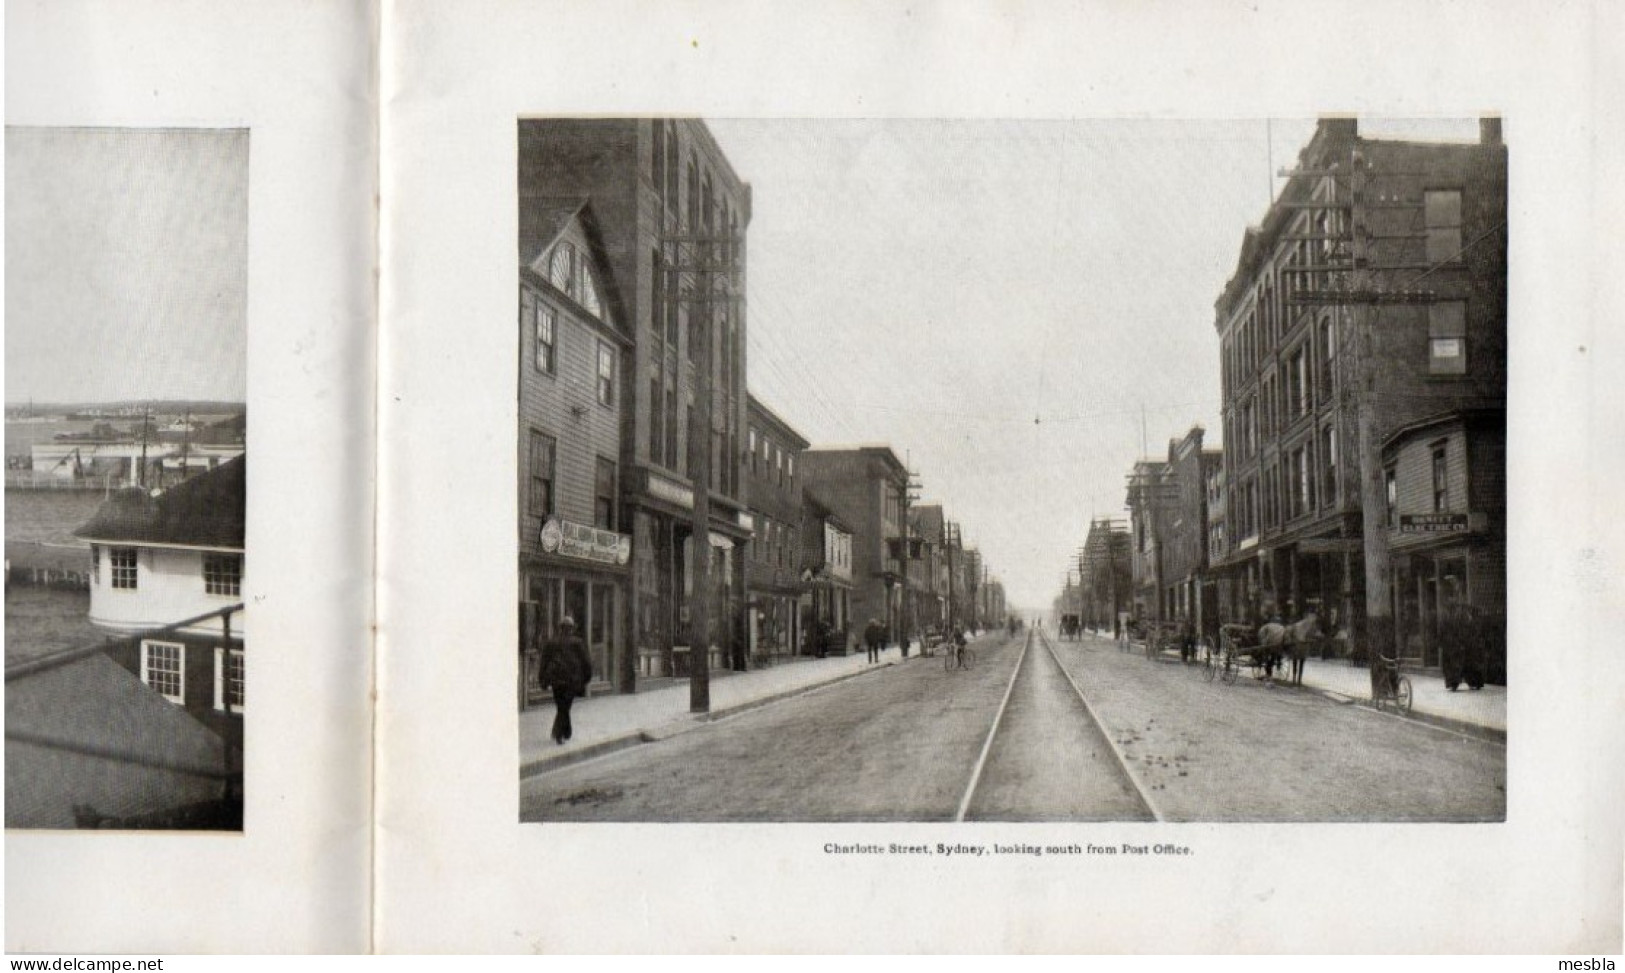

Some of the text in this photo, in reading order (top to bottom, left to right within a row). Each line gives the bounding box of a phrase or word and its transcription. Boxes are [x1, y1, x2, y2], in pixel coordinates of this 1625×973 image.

[822, 843, 1195, 857] Charlotte Street, Sydney, looking south from Post Office.
